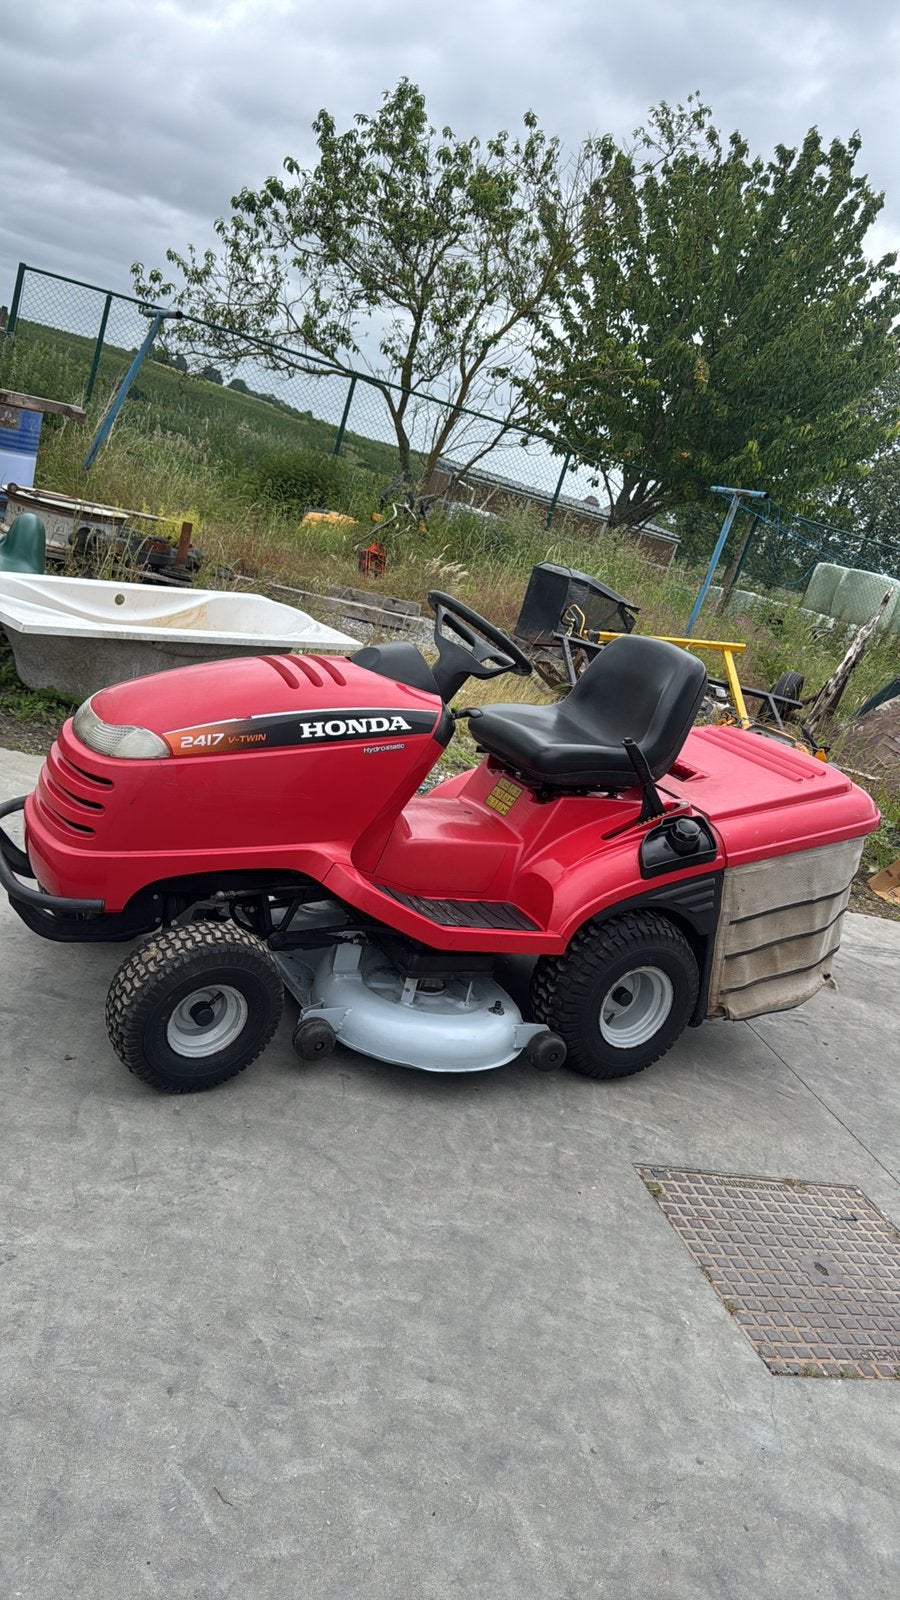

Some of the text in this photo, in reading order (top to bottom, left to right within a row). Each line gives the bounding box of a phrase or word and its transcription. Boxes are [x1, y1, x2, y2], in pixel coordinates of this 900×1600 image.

[300, 716, 412, 738] HONDA
[180, 733, 267, 748] 2417 V-TWIN
[363, 743, 405, 754] Hydrostatic
